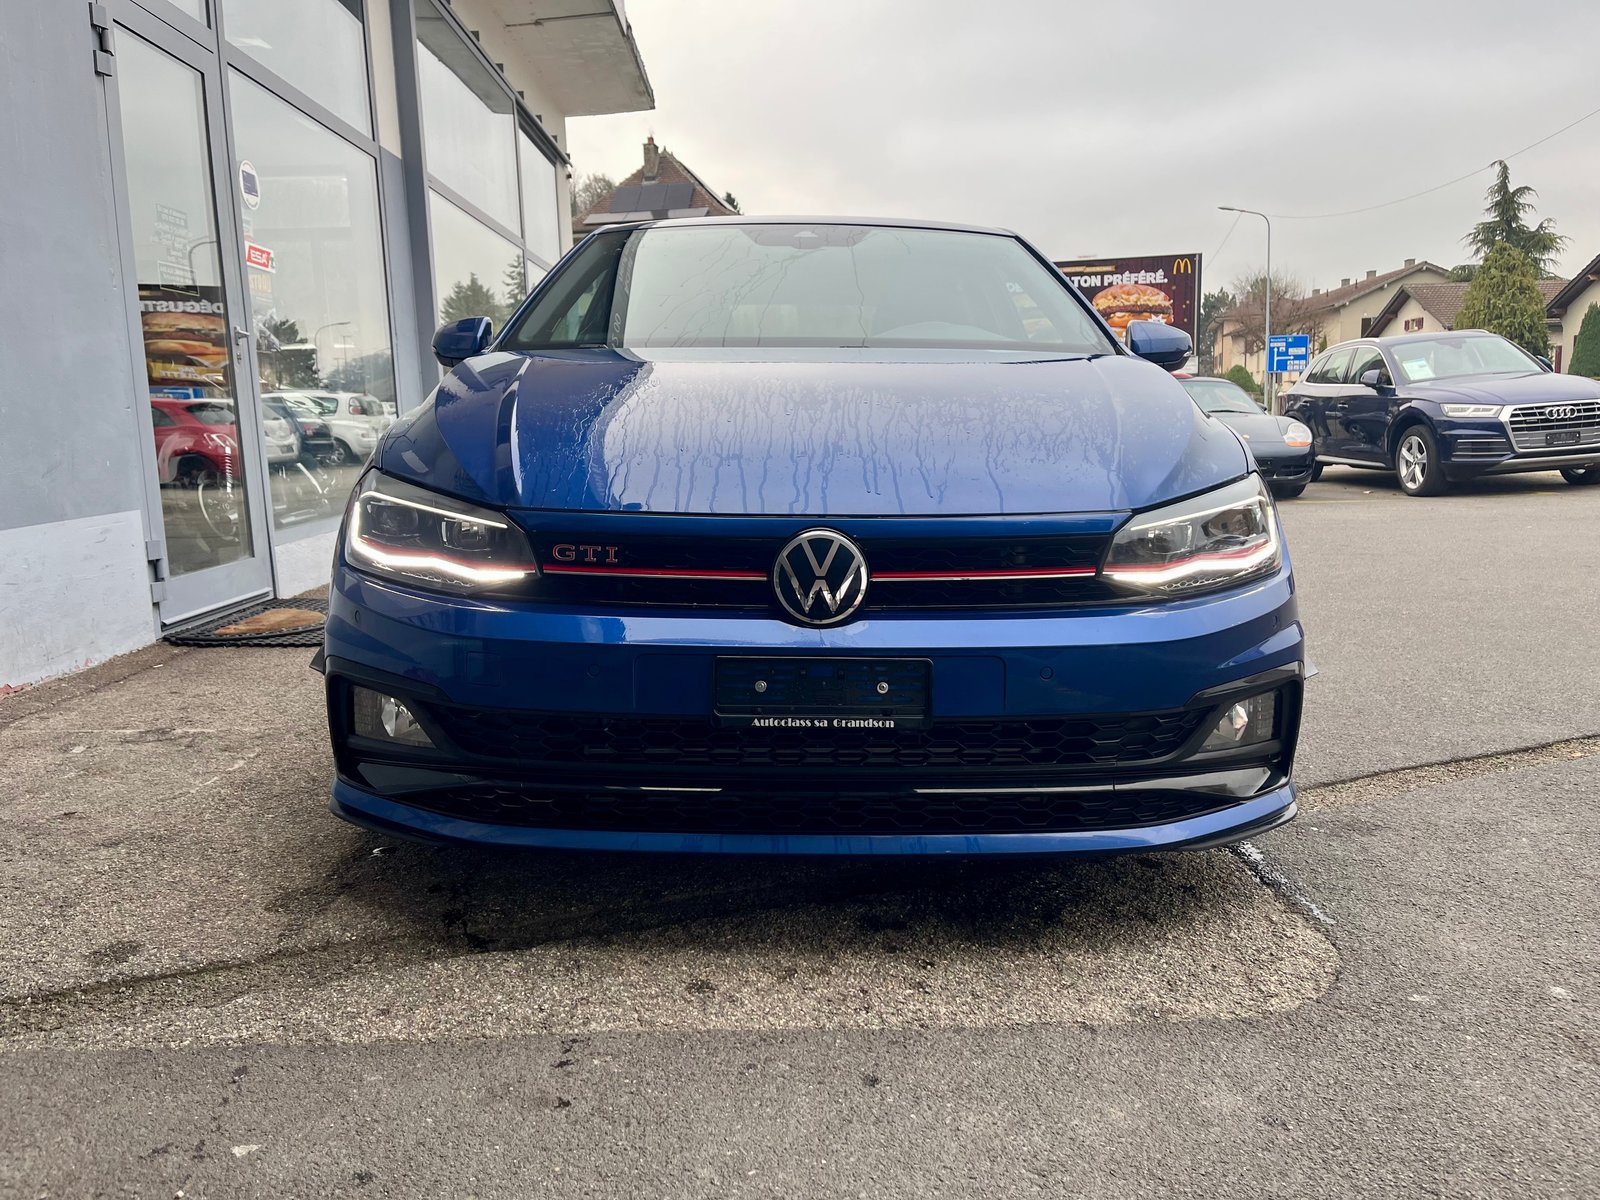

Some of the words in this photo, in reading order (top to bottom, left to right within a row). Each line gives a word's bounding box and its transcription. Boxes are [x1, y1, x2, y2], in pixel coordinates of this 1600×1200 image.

[1103, 269, 1168, 286] PRÉFÉRÉ.
[552, 543, 618, 563] GTI
[751, 717, 812, 727] Autoclass
[813, 718, 828, 727] sa
[832, 718, 895, 728] Grandson
